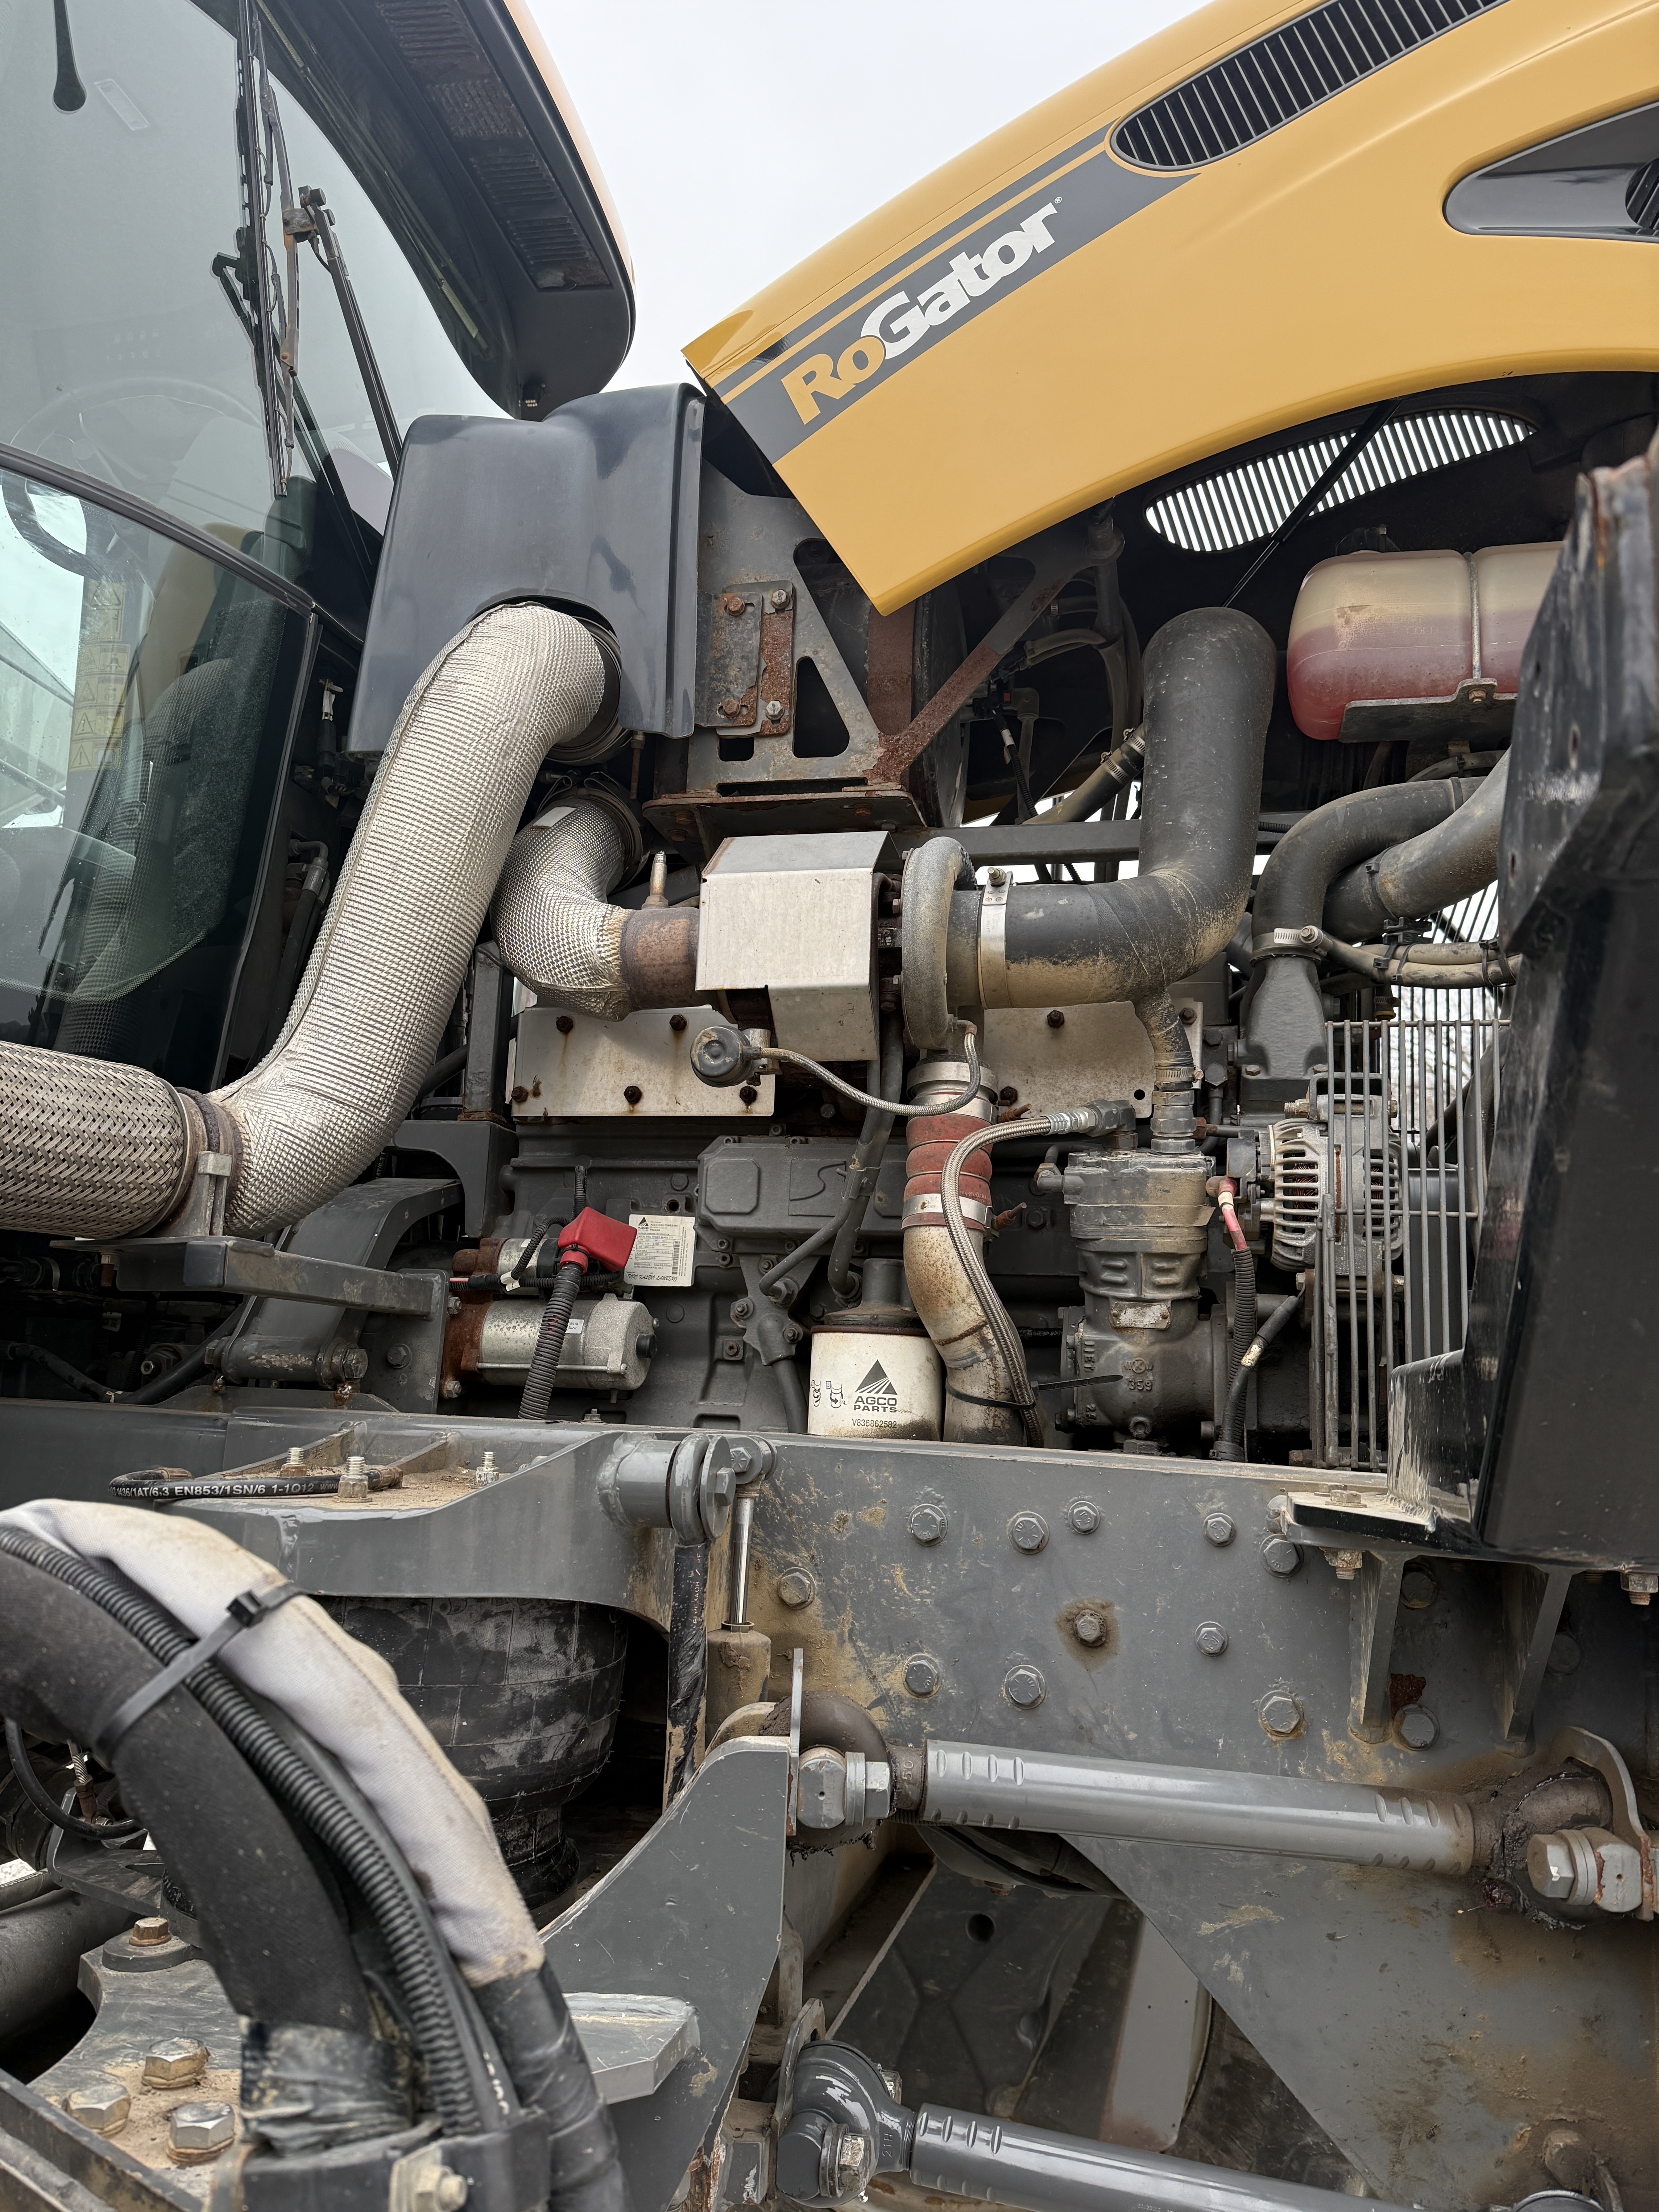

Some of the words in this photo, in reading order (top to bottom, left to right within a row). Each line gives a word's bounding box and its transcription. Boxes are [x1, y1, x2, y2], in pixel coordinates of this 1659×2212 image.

[1128, 1379, 1152, 1391] 359
[854, 1396, 897, 1406] AGCO
[852, 1419, 897, 1428] V836862582
[175, 1485, 266, 1496] EN853/1SN/6
